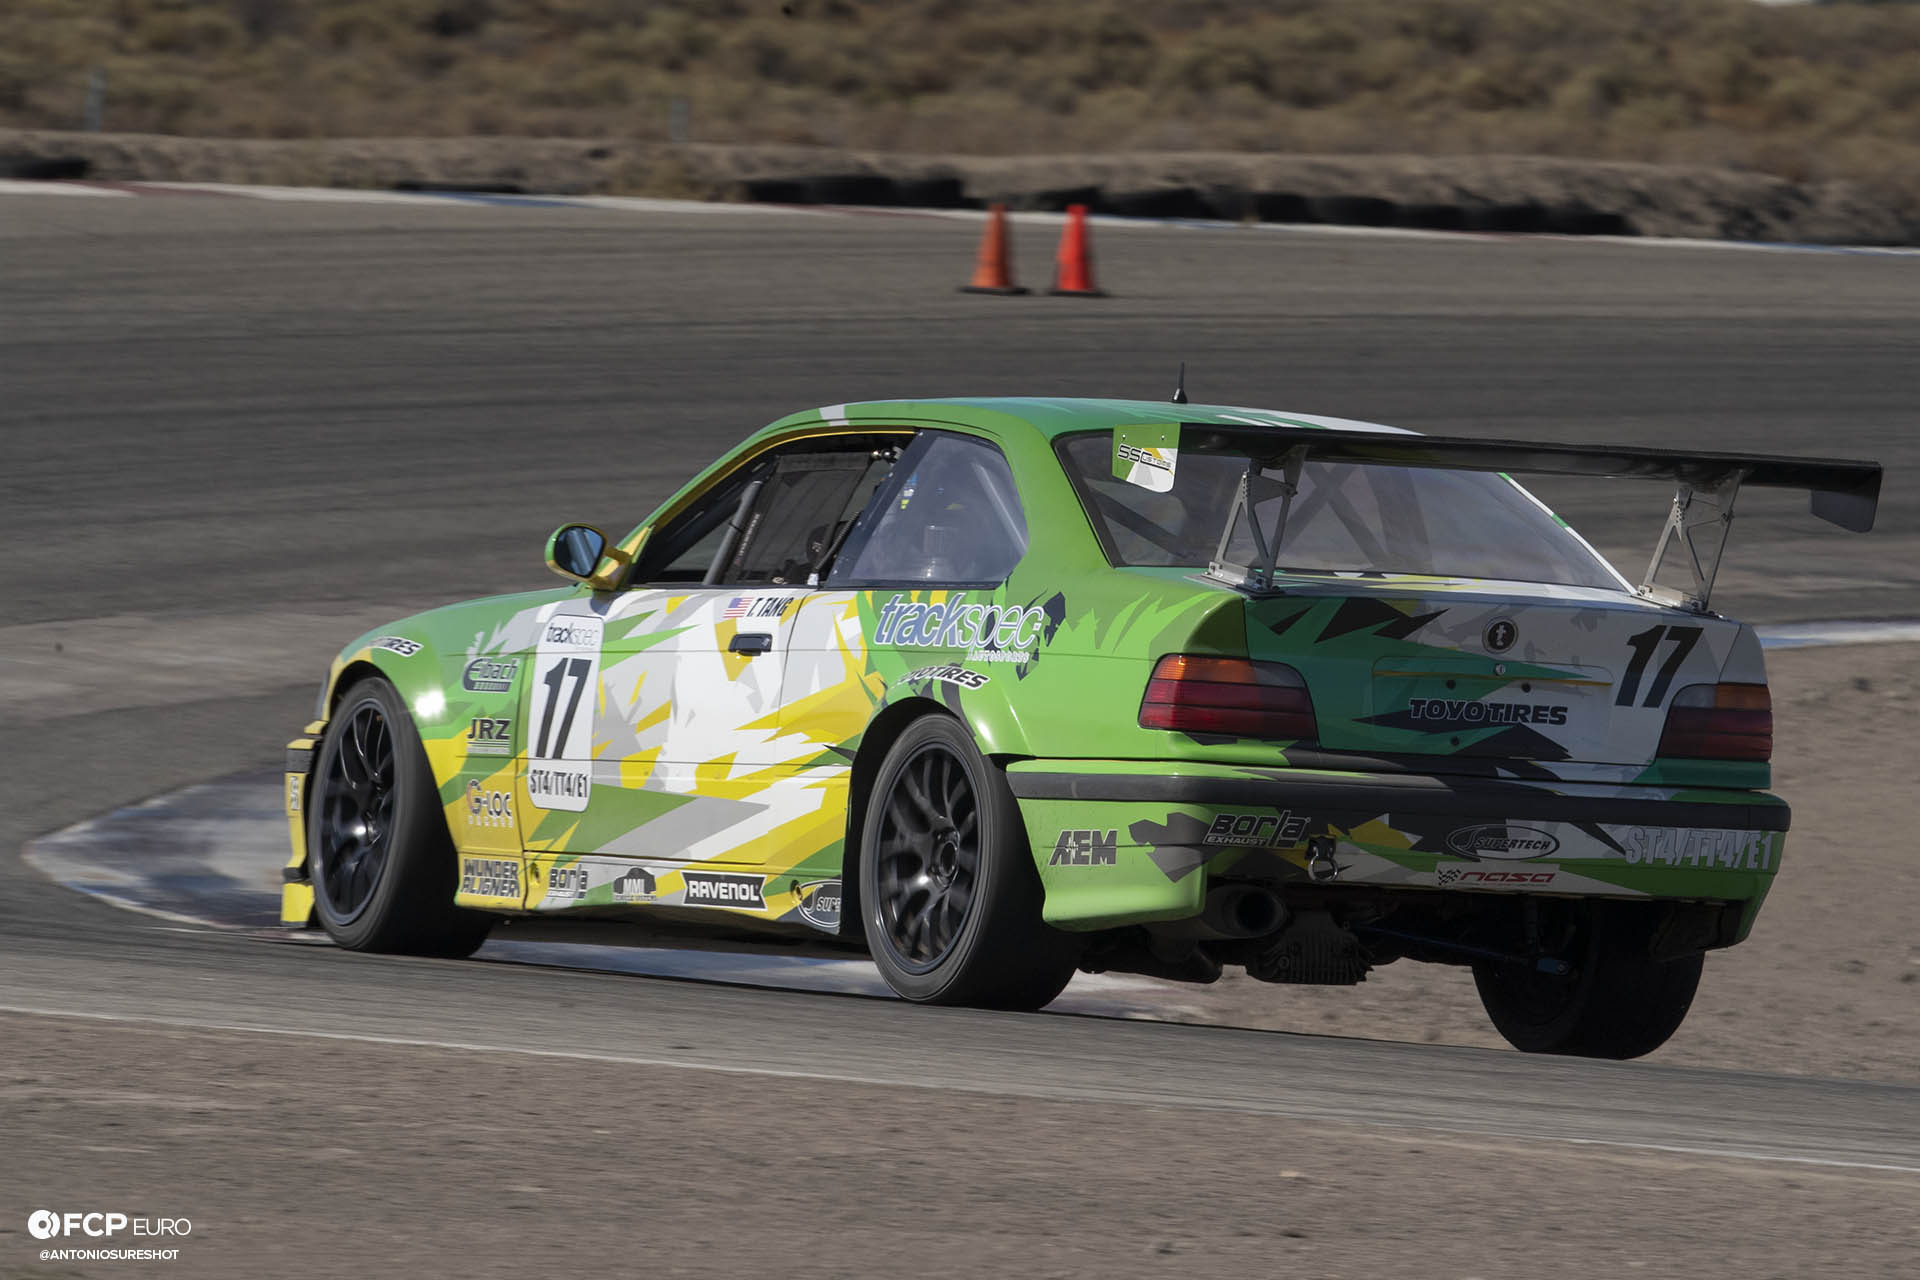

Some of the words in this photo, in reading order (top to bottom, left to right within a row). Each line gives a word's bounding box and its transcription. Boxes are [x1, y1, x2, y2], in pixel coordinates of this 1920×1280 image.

[757, 597, 794, 617] TANG
[873, 592, 1044, 659] trackspec
[1614, 624, 1704, 708] 17
[535, 657, 593, 760] 17
[1408, 698, 1488, 722] TOYO
[1488, 702, 1568, 726] TIRES
[467, 718, 511, 740] JRZ
[529, 768, 590, 798] ST4/TT4/E1
[466, 778, 513, 817] G-LOC
[1049, 829, 1118, 866] AEM
[1204, 835, 1266, 847] EXHAUST
[1474, 836, 1552, 851] SUPERTECH
[1624, 826, 1773, 870] ST4/TT4/E1
[462, 858, 519, 879] WUNDER
[461, 876, 521, 899] ALIGNER
[623, 878, 645, 896] MML
[688, 880, 760, 901] RAVENOL
